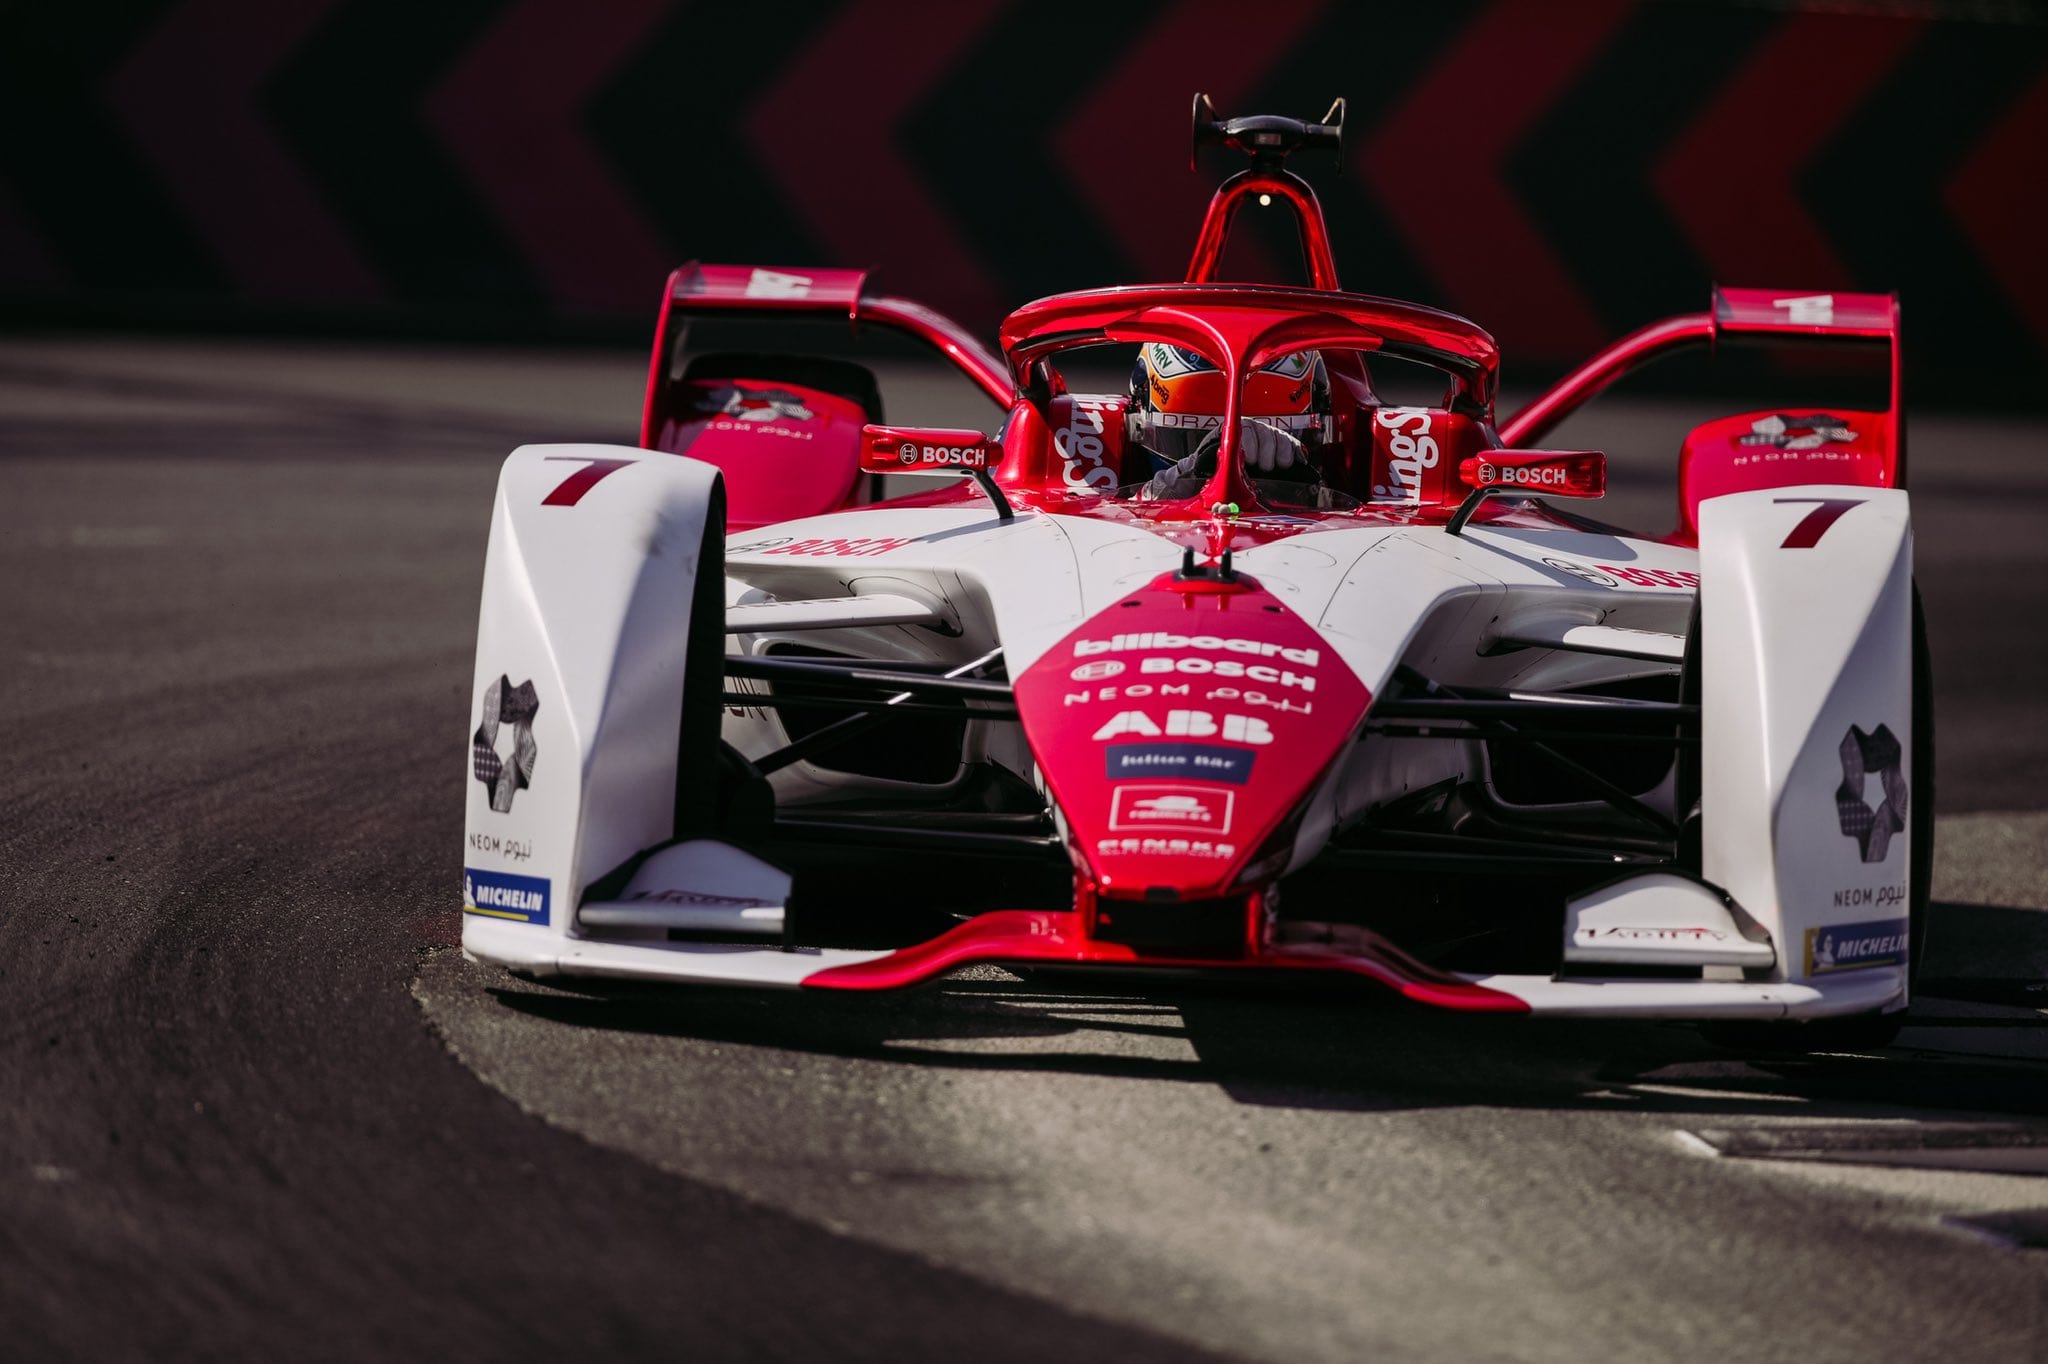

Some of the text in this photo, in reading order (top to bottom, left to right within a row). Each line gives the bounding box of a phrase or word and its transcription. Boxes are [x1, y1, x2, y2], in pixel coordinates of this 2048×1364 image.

[1162, 413, 1293, 429] DRAON
[923, 445, 985, 466] BOSCH
[540, 457, 641, 507] 7
[1502, 467, 1567, 485] BOSCH
[1773, 498, 1872, 549] 7
[761, 538, 912, 557] BOSCH
[1073, 632, 1320, 668] billboard
[1140, 657, 1317, 692] BOSCH
[1063, 684, 1190, 707] NEOM
[1092, 709, 1275, 745] ABB
[468, 833, 501, 851] NEOM
[476, 884, 544, 912] MICHELIN
[1834, 888, 1873, 908] NEOM
